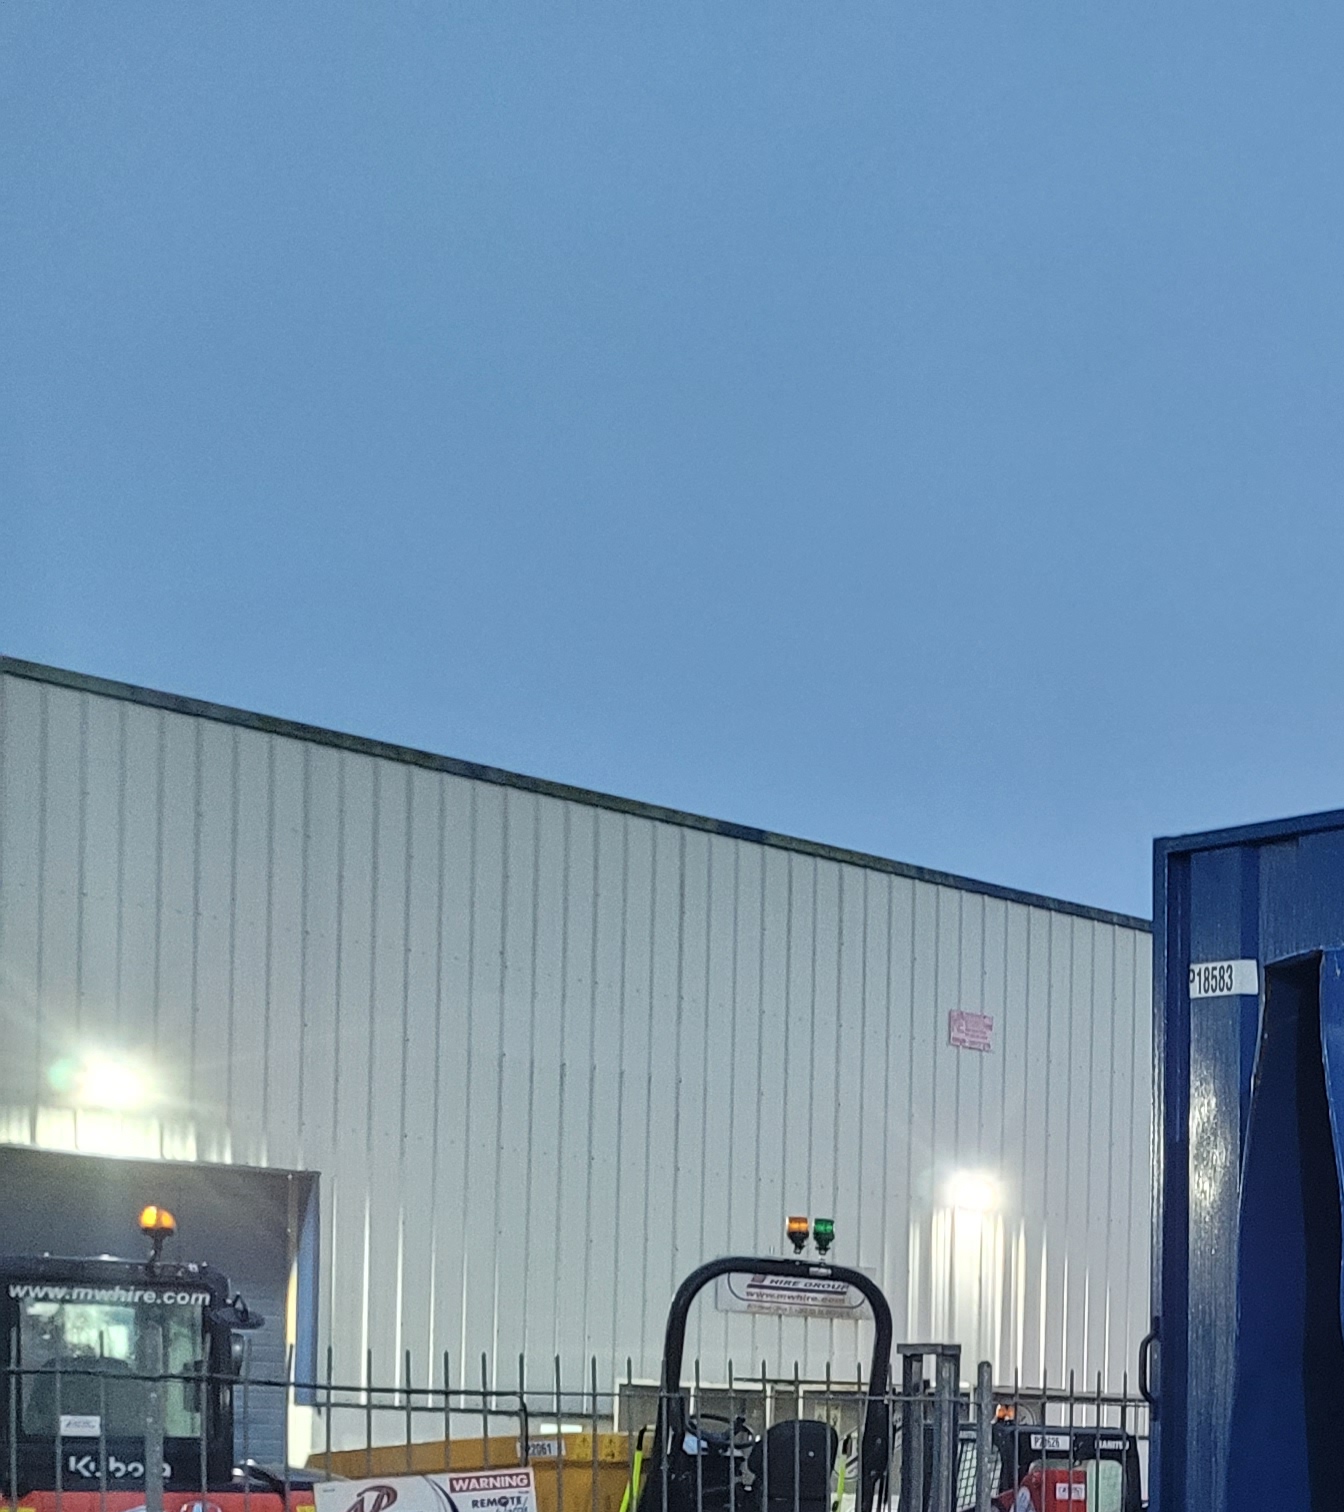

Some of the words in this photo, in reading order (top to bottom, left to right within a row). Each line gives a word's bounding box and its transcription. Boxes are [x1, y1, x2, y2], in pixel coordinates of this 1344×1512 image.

[1189, 964, 1234, 995] P18583
[9, 1284, 211, 1306] www.mwhire.com
[452, 1475, 528, 1491] WARNING
[471, 1495, 522, 1509] REMOTE
